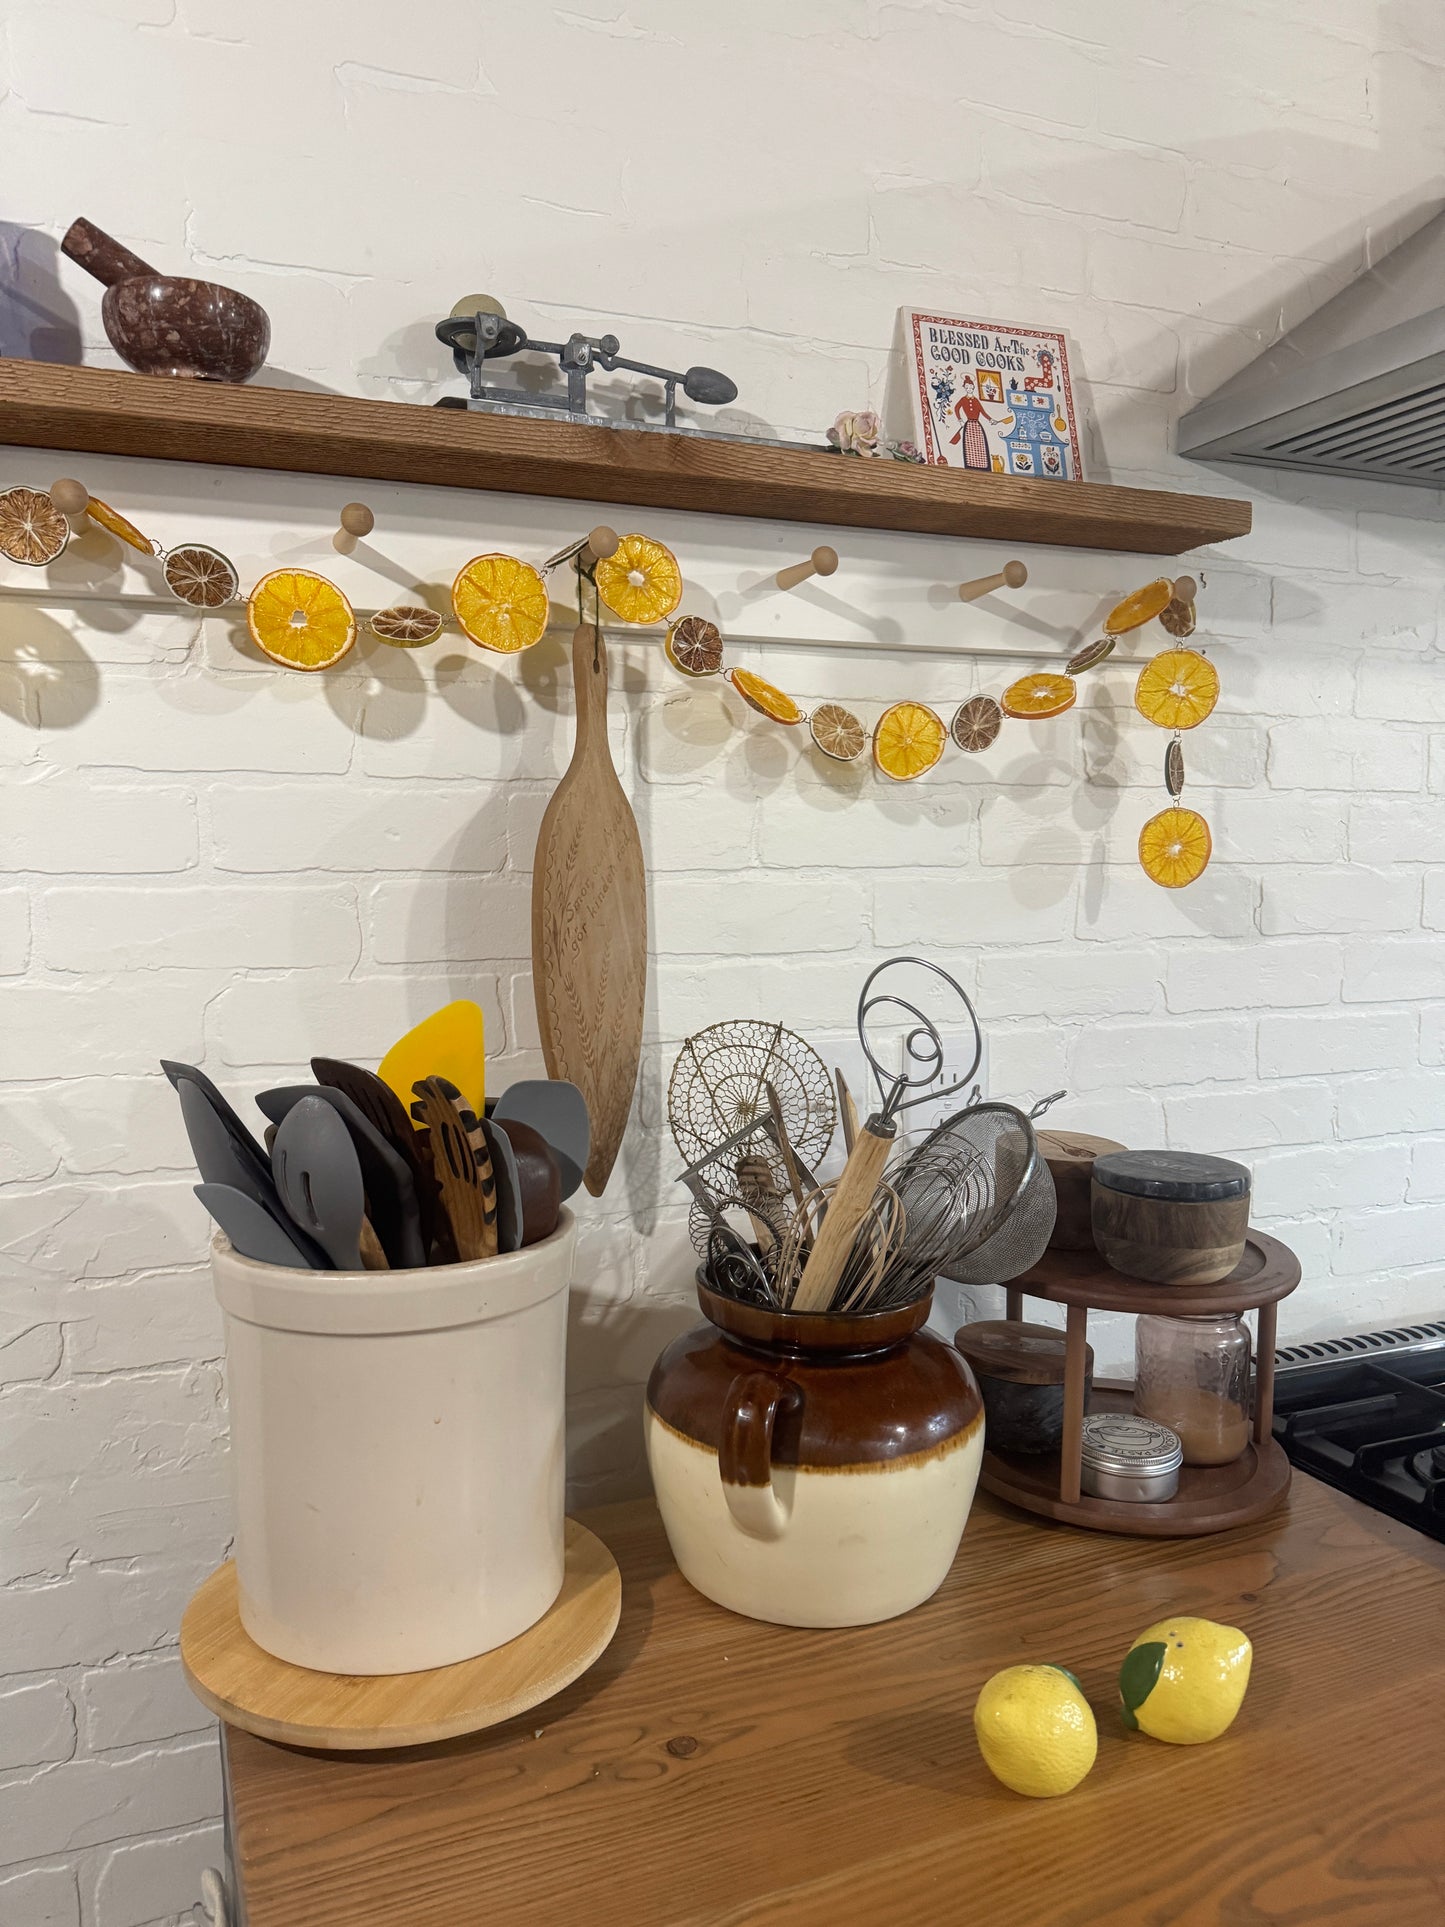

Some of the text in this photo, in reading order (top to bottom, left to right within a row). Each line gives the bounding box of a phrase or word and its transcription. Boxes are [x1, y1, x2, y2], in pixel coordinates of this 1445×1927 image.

[929, 327, 1029, 357] BLESSED Are The
[930, 345, 1025, 372] GOOD COOKS
[1133, 1417, 1158, 1428] IRON
[1113, 1448, 1152, 1456] PASTE
